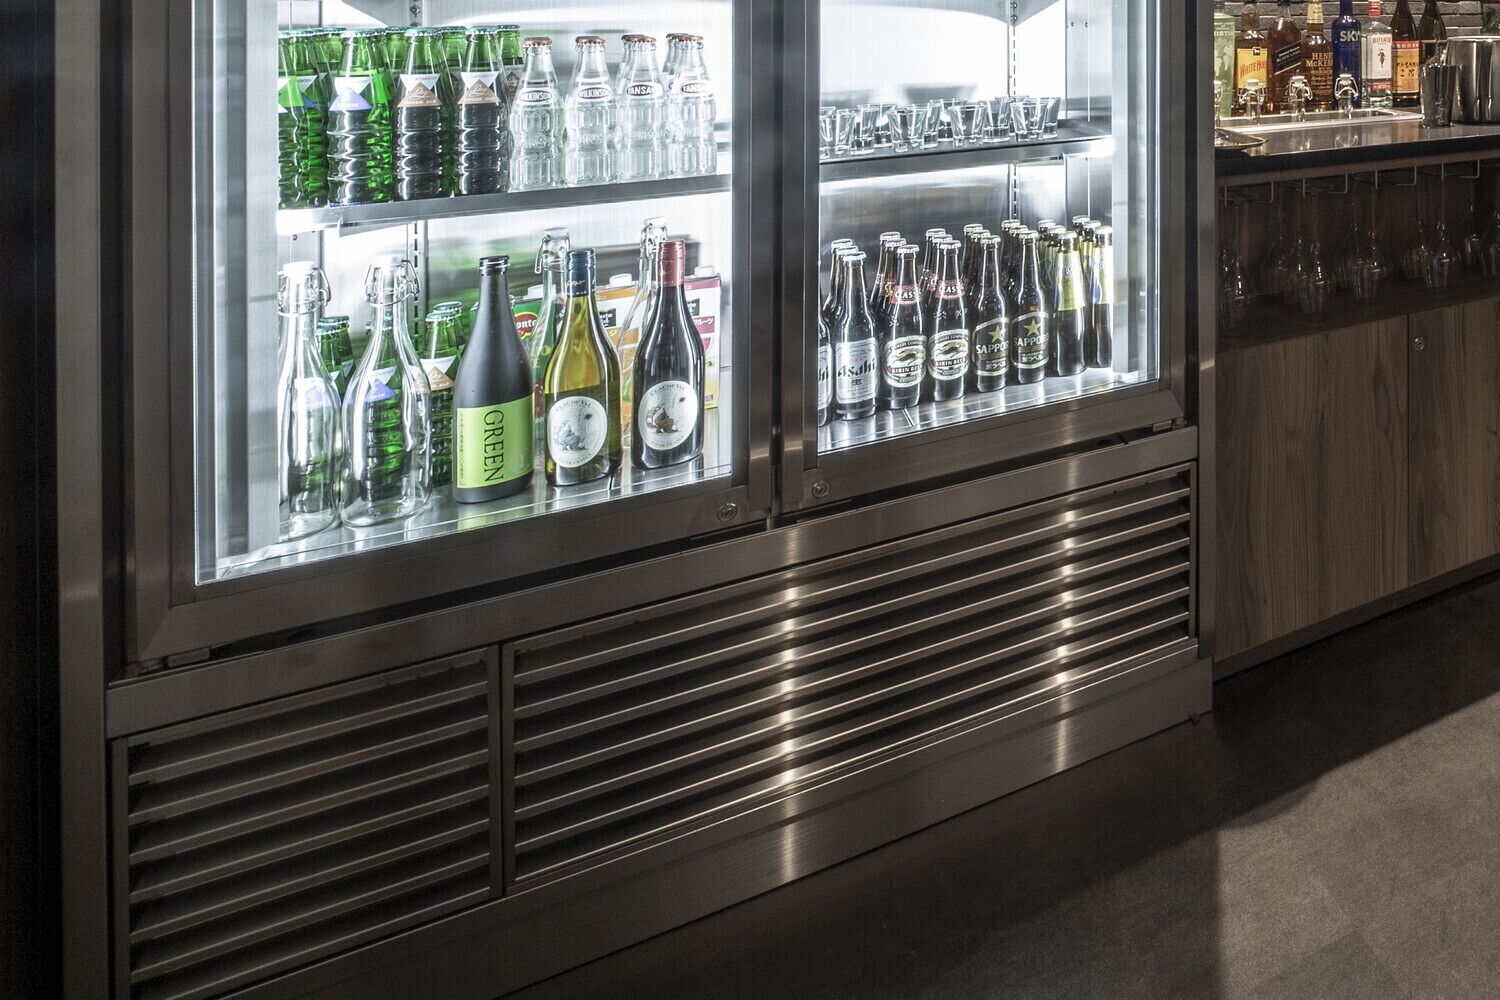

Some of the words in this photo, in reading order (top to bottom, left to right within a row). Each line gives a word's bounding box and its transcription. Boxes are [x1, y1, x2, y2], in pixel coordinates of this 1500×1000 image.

[1240, 62, 1257, 79] WHITE
[838, 358, 875, 378] Asahi
[484, 410, 504, 481] GREEN
